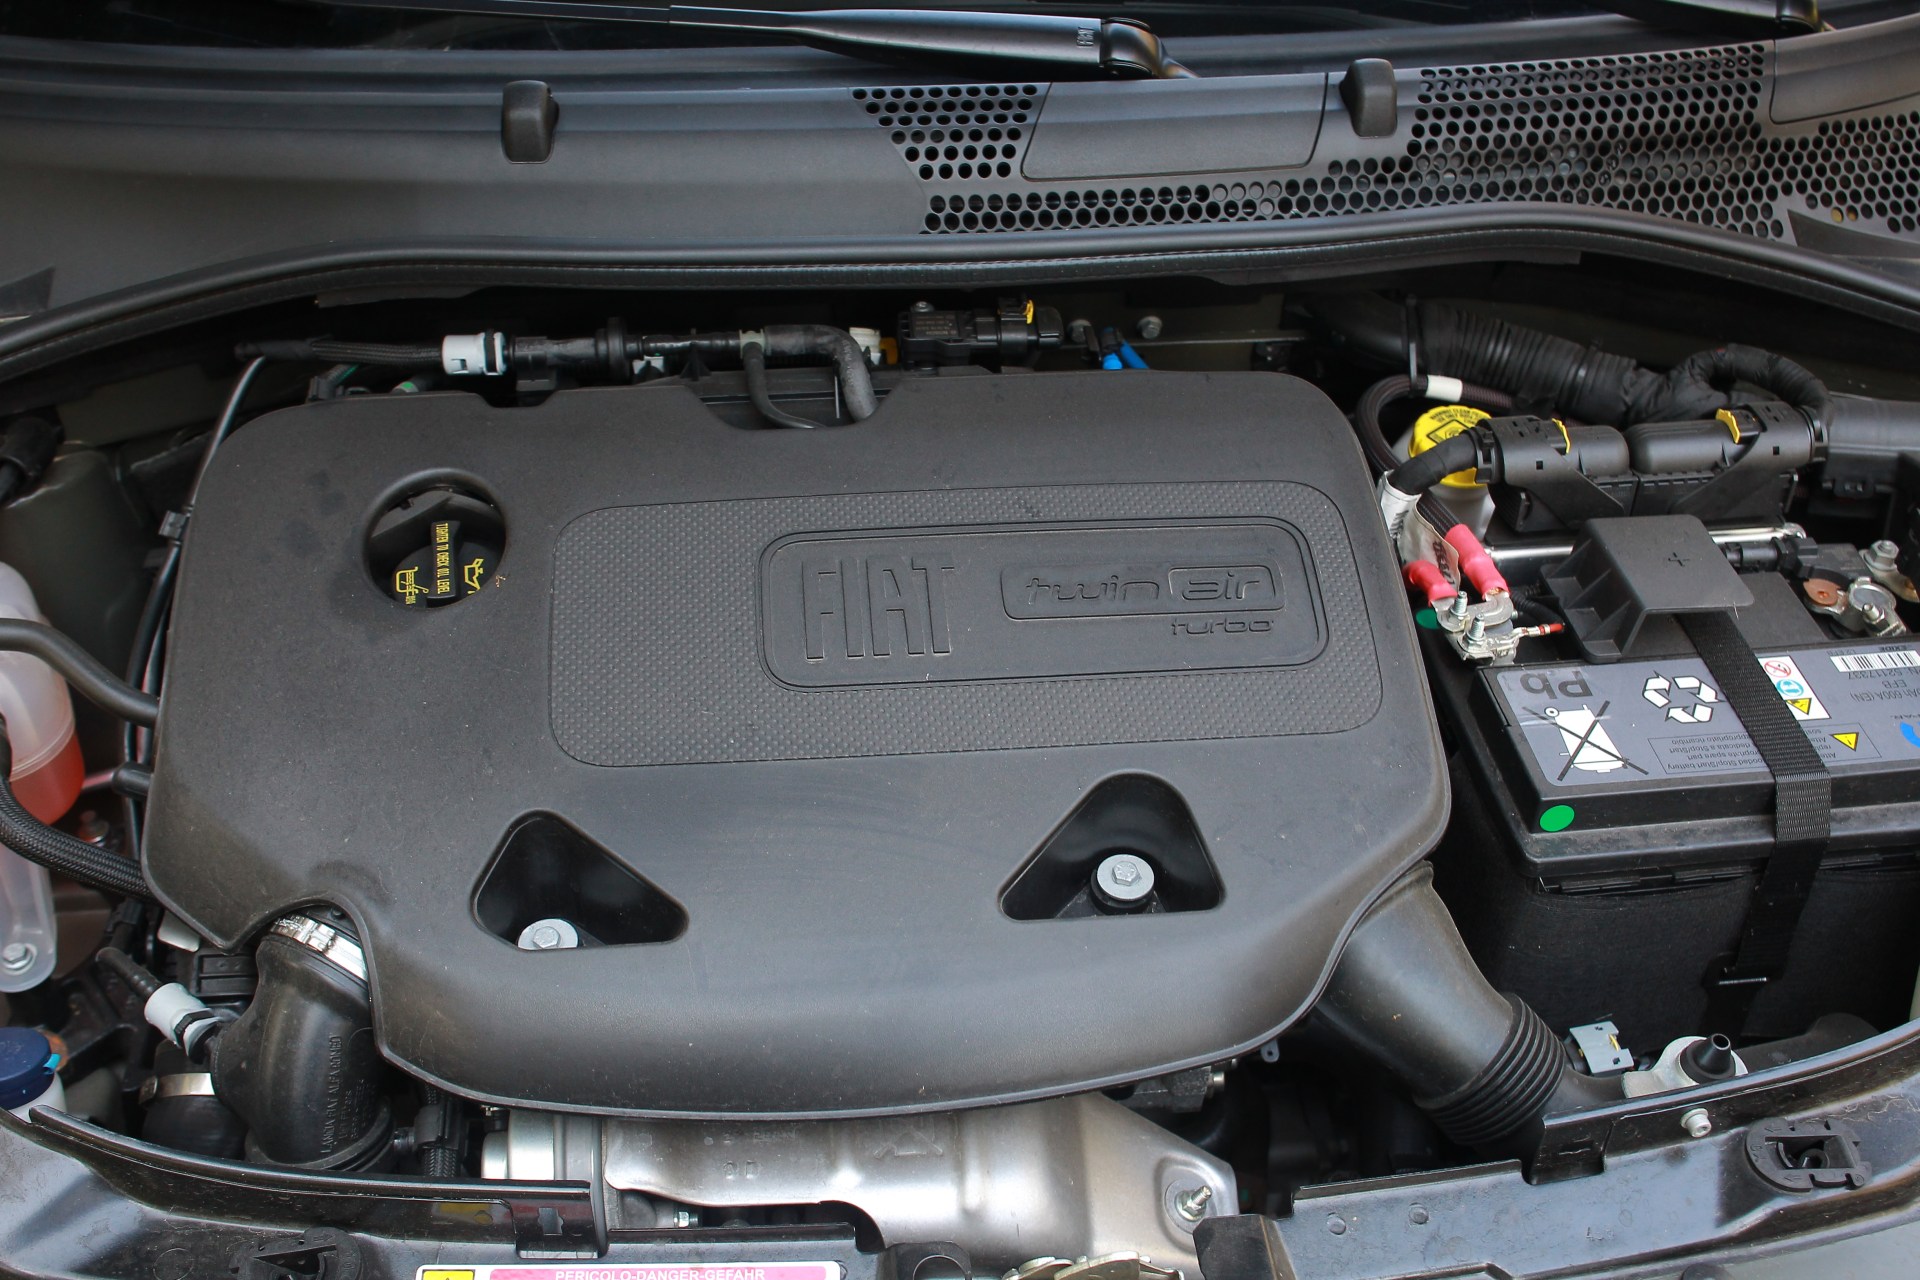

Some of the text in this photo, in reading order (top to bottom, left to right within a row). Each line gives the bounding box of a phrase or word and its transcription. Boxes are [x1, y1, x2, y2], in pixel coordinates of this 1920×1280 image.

[436, 523, 448, 543] TIGHTEN
[437, 552, 449, 567] CHECK
[437, 568, 449, 578] OIL
[437, 579, 450, 594] LEVEL
[1025, 571, 1261, 604] twin air
[801, 555, 956, 661] FIAT
[1171, 616, 1275, 636] turbo
[1520, 670, 1593, 699] Pb
[1882, 680, 1907, 689] EFB
[1849, 689, 1875, 703] (EN)
[1874, 690, 1903, 701] 600A
[1669, 744, 1709, 753] Stop/Start
[1697, 760, 1738, 769] Stop/Start
[328, 1069, 340, 1094] ALFA
[555, 1268, 765, 1280] PERICOLO-DANGER-GEFAHR
